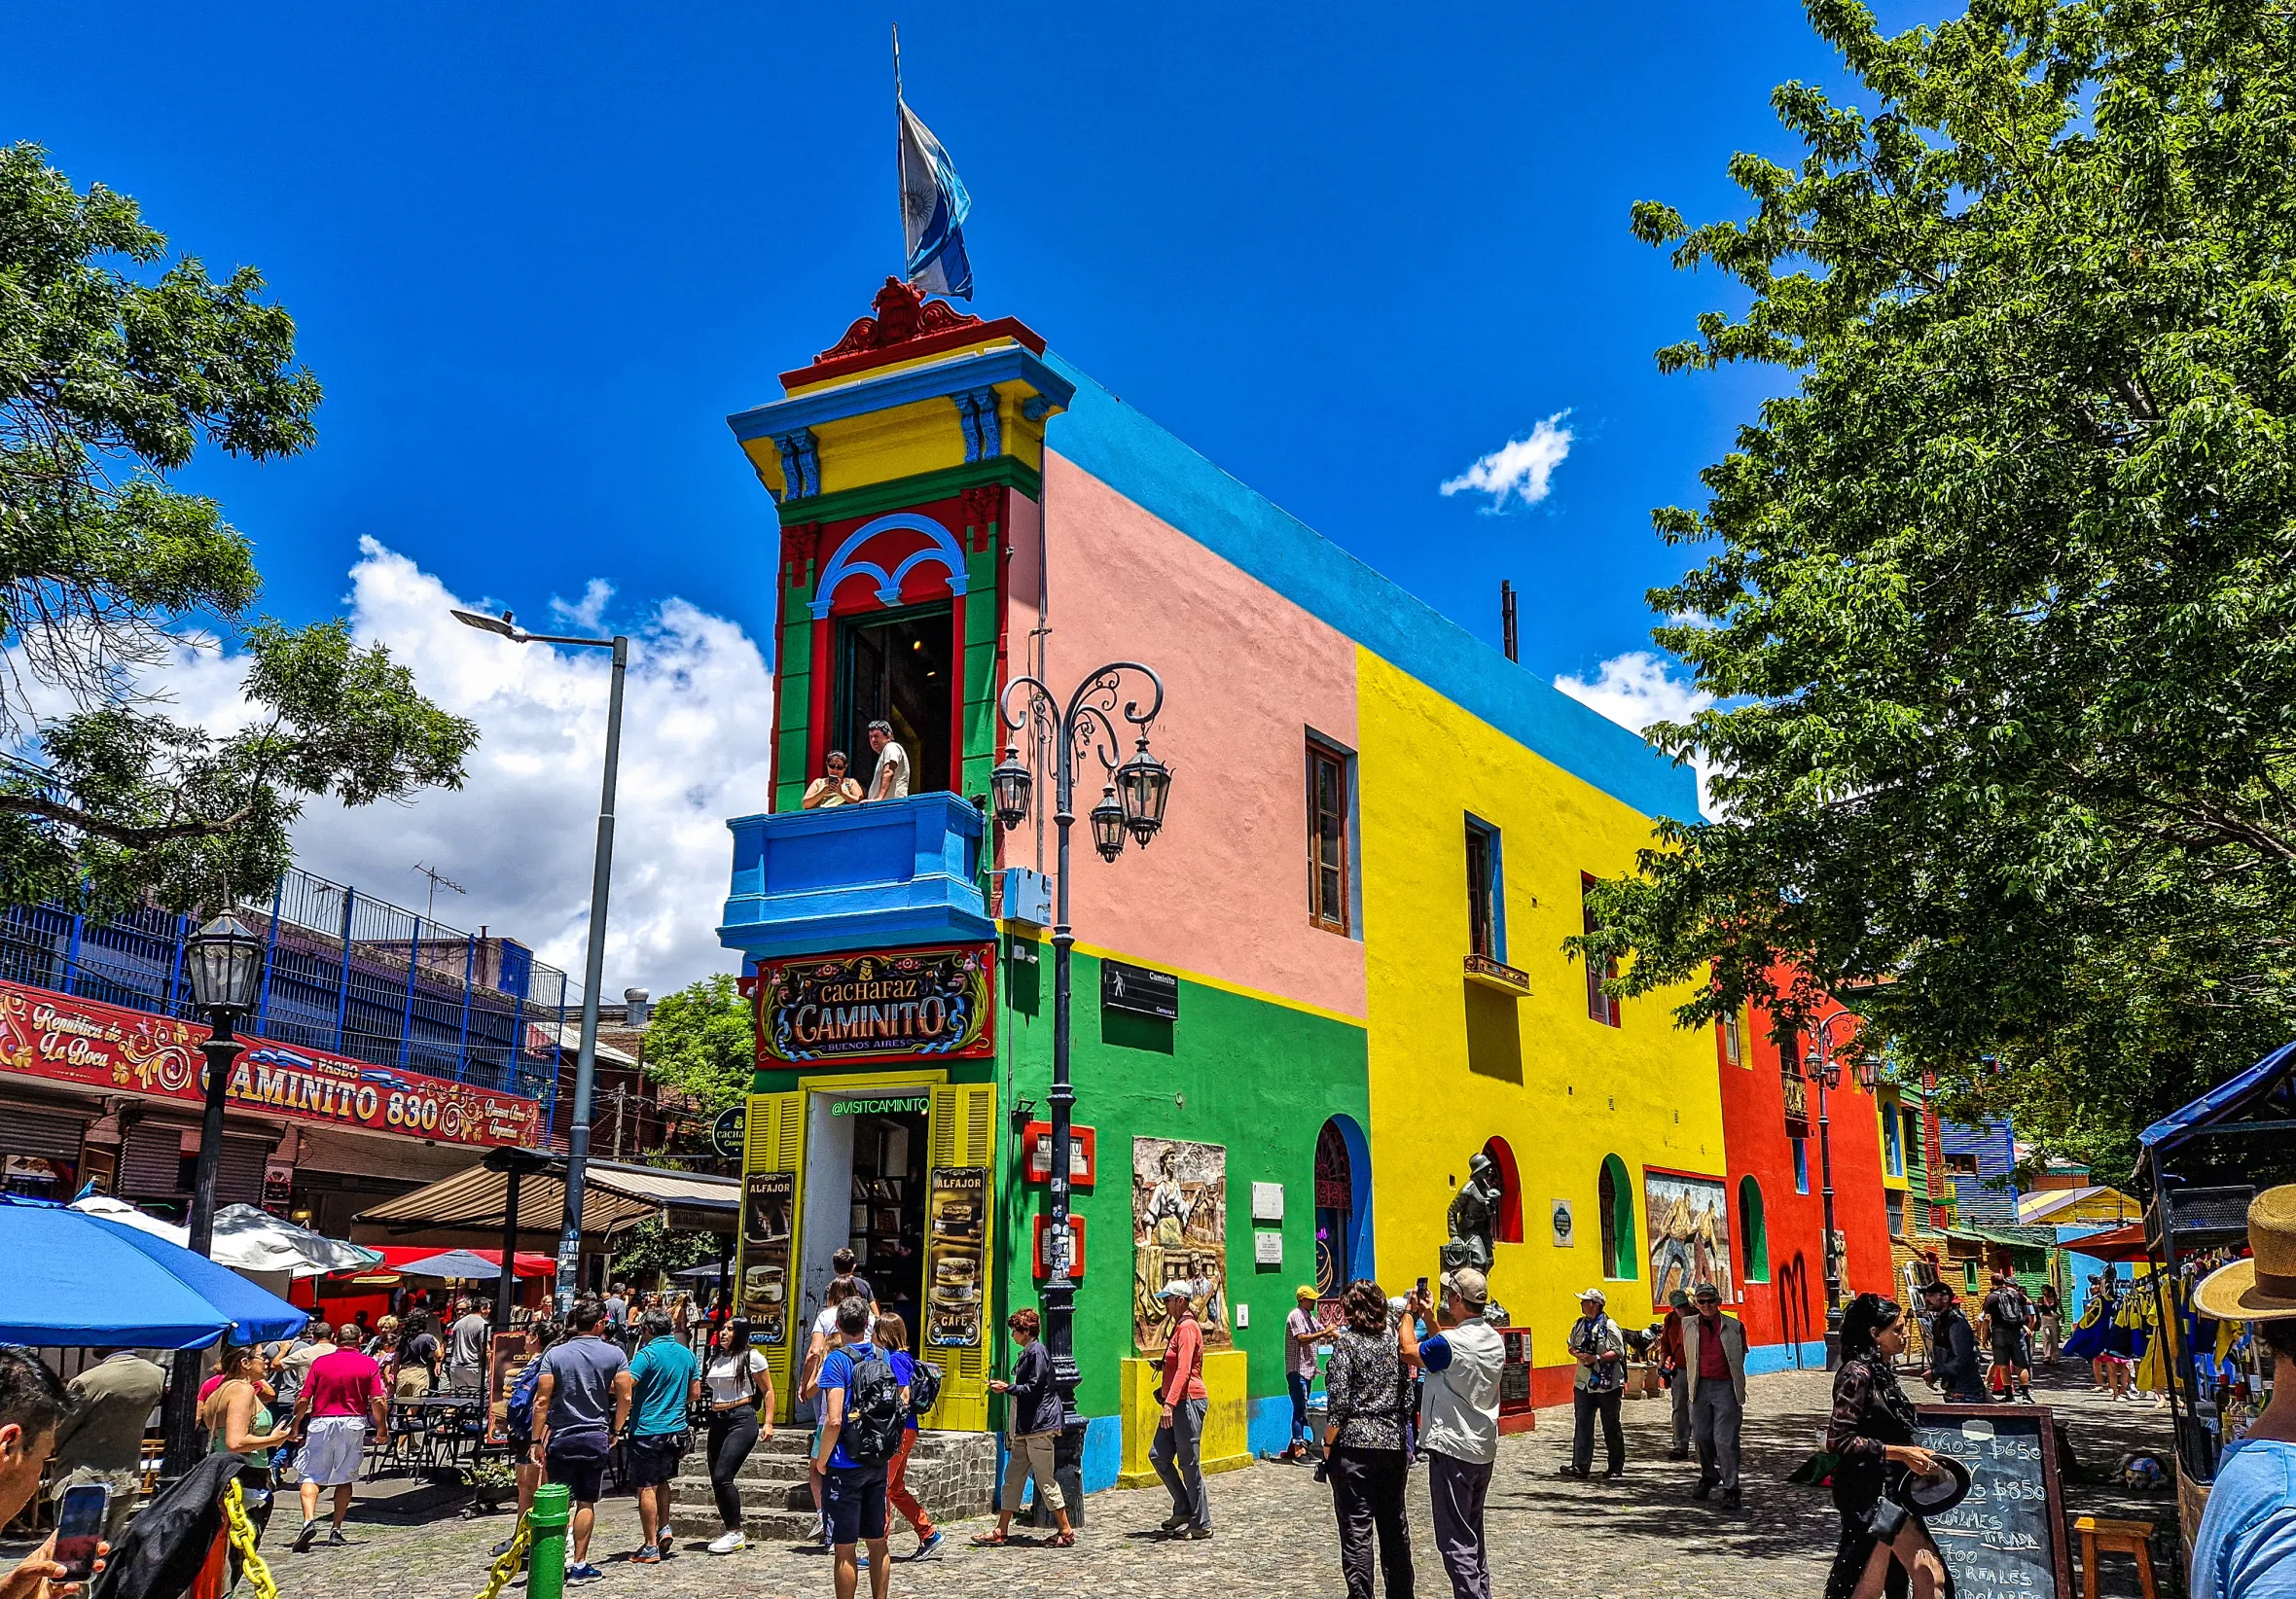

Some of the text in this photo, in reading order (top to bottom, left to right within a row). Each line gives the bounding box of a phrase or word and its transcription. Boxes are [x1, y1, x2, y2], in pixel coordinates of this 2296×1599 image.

[1149, 972, 1175, 985] Caminito
[794, 995, 947, 1043] CAMINITO
[104, 1020, 122, 1042] de
[39, 1032, 109, 1068] La Boca
[828, 1039, 906, 1051] BUENOS AIRES
[316, 1057, 359, 1080] PASEO
[387, 1091, 438, 1130] 830
[831, 1097, 930, 1117] @VISITCAMINITO
[749, 1184, 790, 1193] ALFAJOR
[937, 1178, 982, 1189] ALFAJOR
[1988, 1436, 2042, 1460] $650
[1991, 1477, 2046, 1502] $850
[1965, 1565, 2033, 1586] REALES
